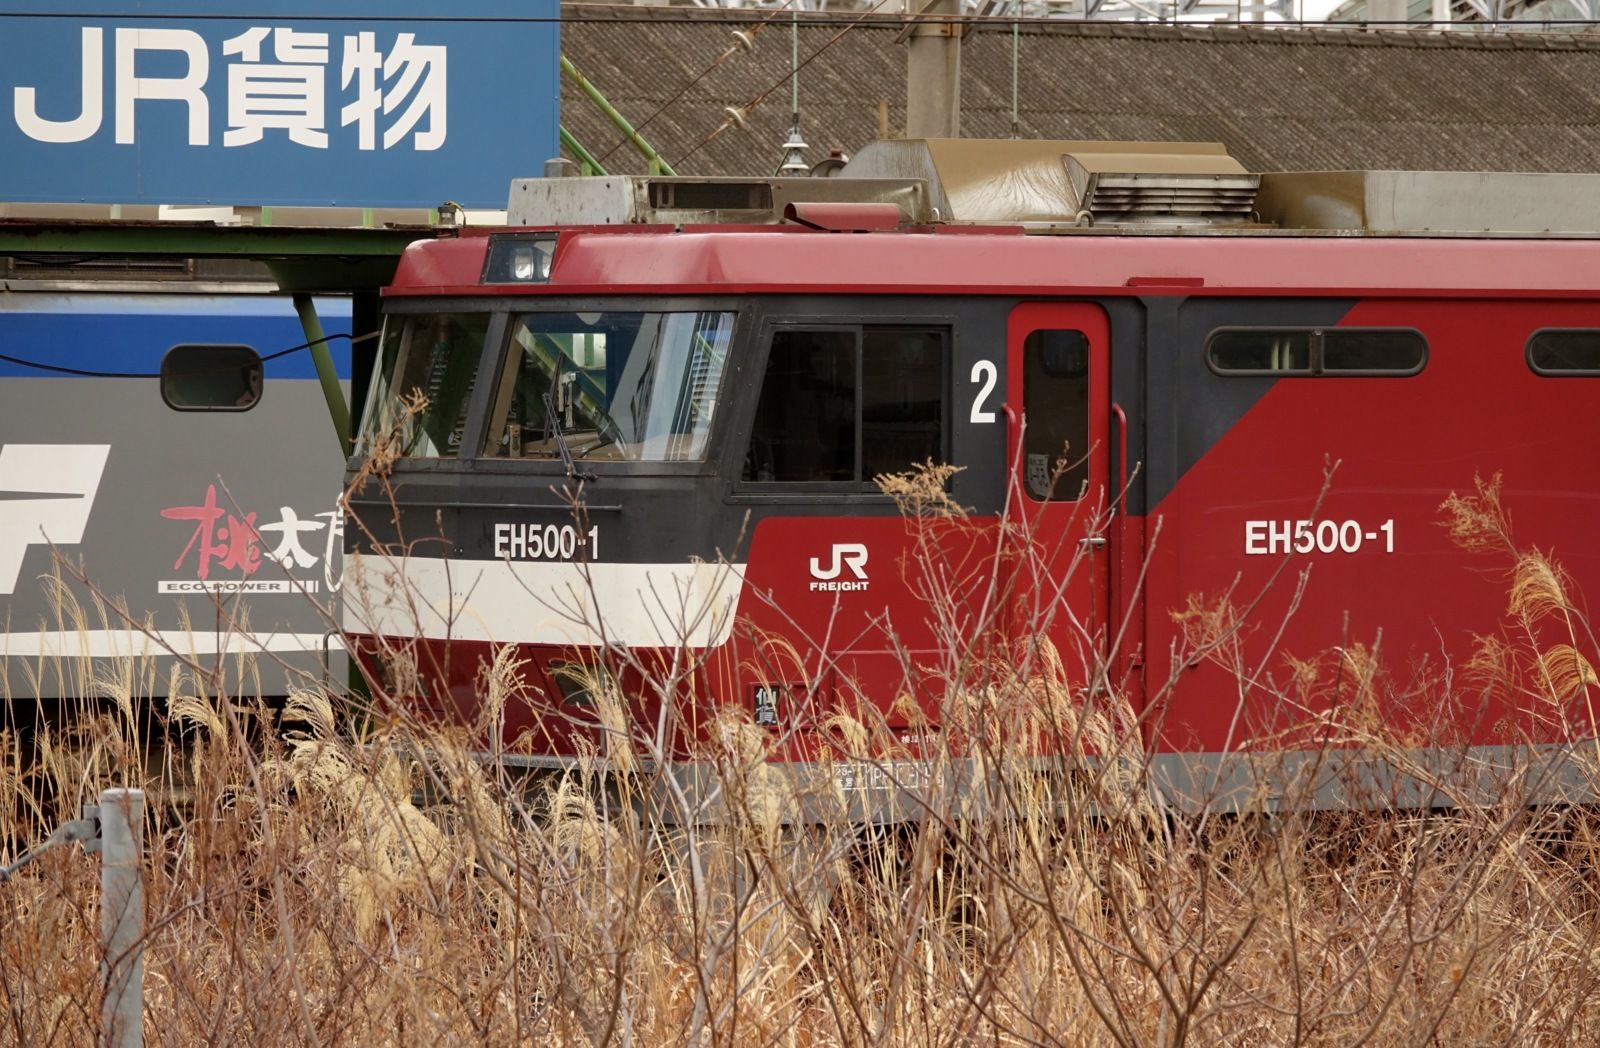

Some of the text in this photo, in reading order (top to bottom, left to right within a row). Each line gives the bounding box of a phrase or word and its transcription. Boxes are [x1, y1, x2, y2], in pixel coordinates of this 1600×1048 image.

[14, 26, 447, 151] JR貨物
[969, 359, 998, 423] 2
[494, 523, 598, 560] EH500-1
[1245, 519, 1395, 554] EH500-1
[810, 543, 868, 580] JR
[166, 583, 281, 591] ECO-POWER
[810, 581, 869, 591] FREIGHT
